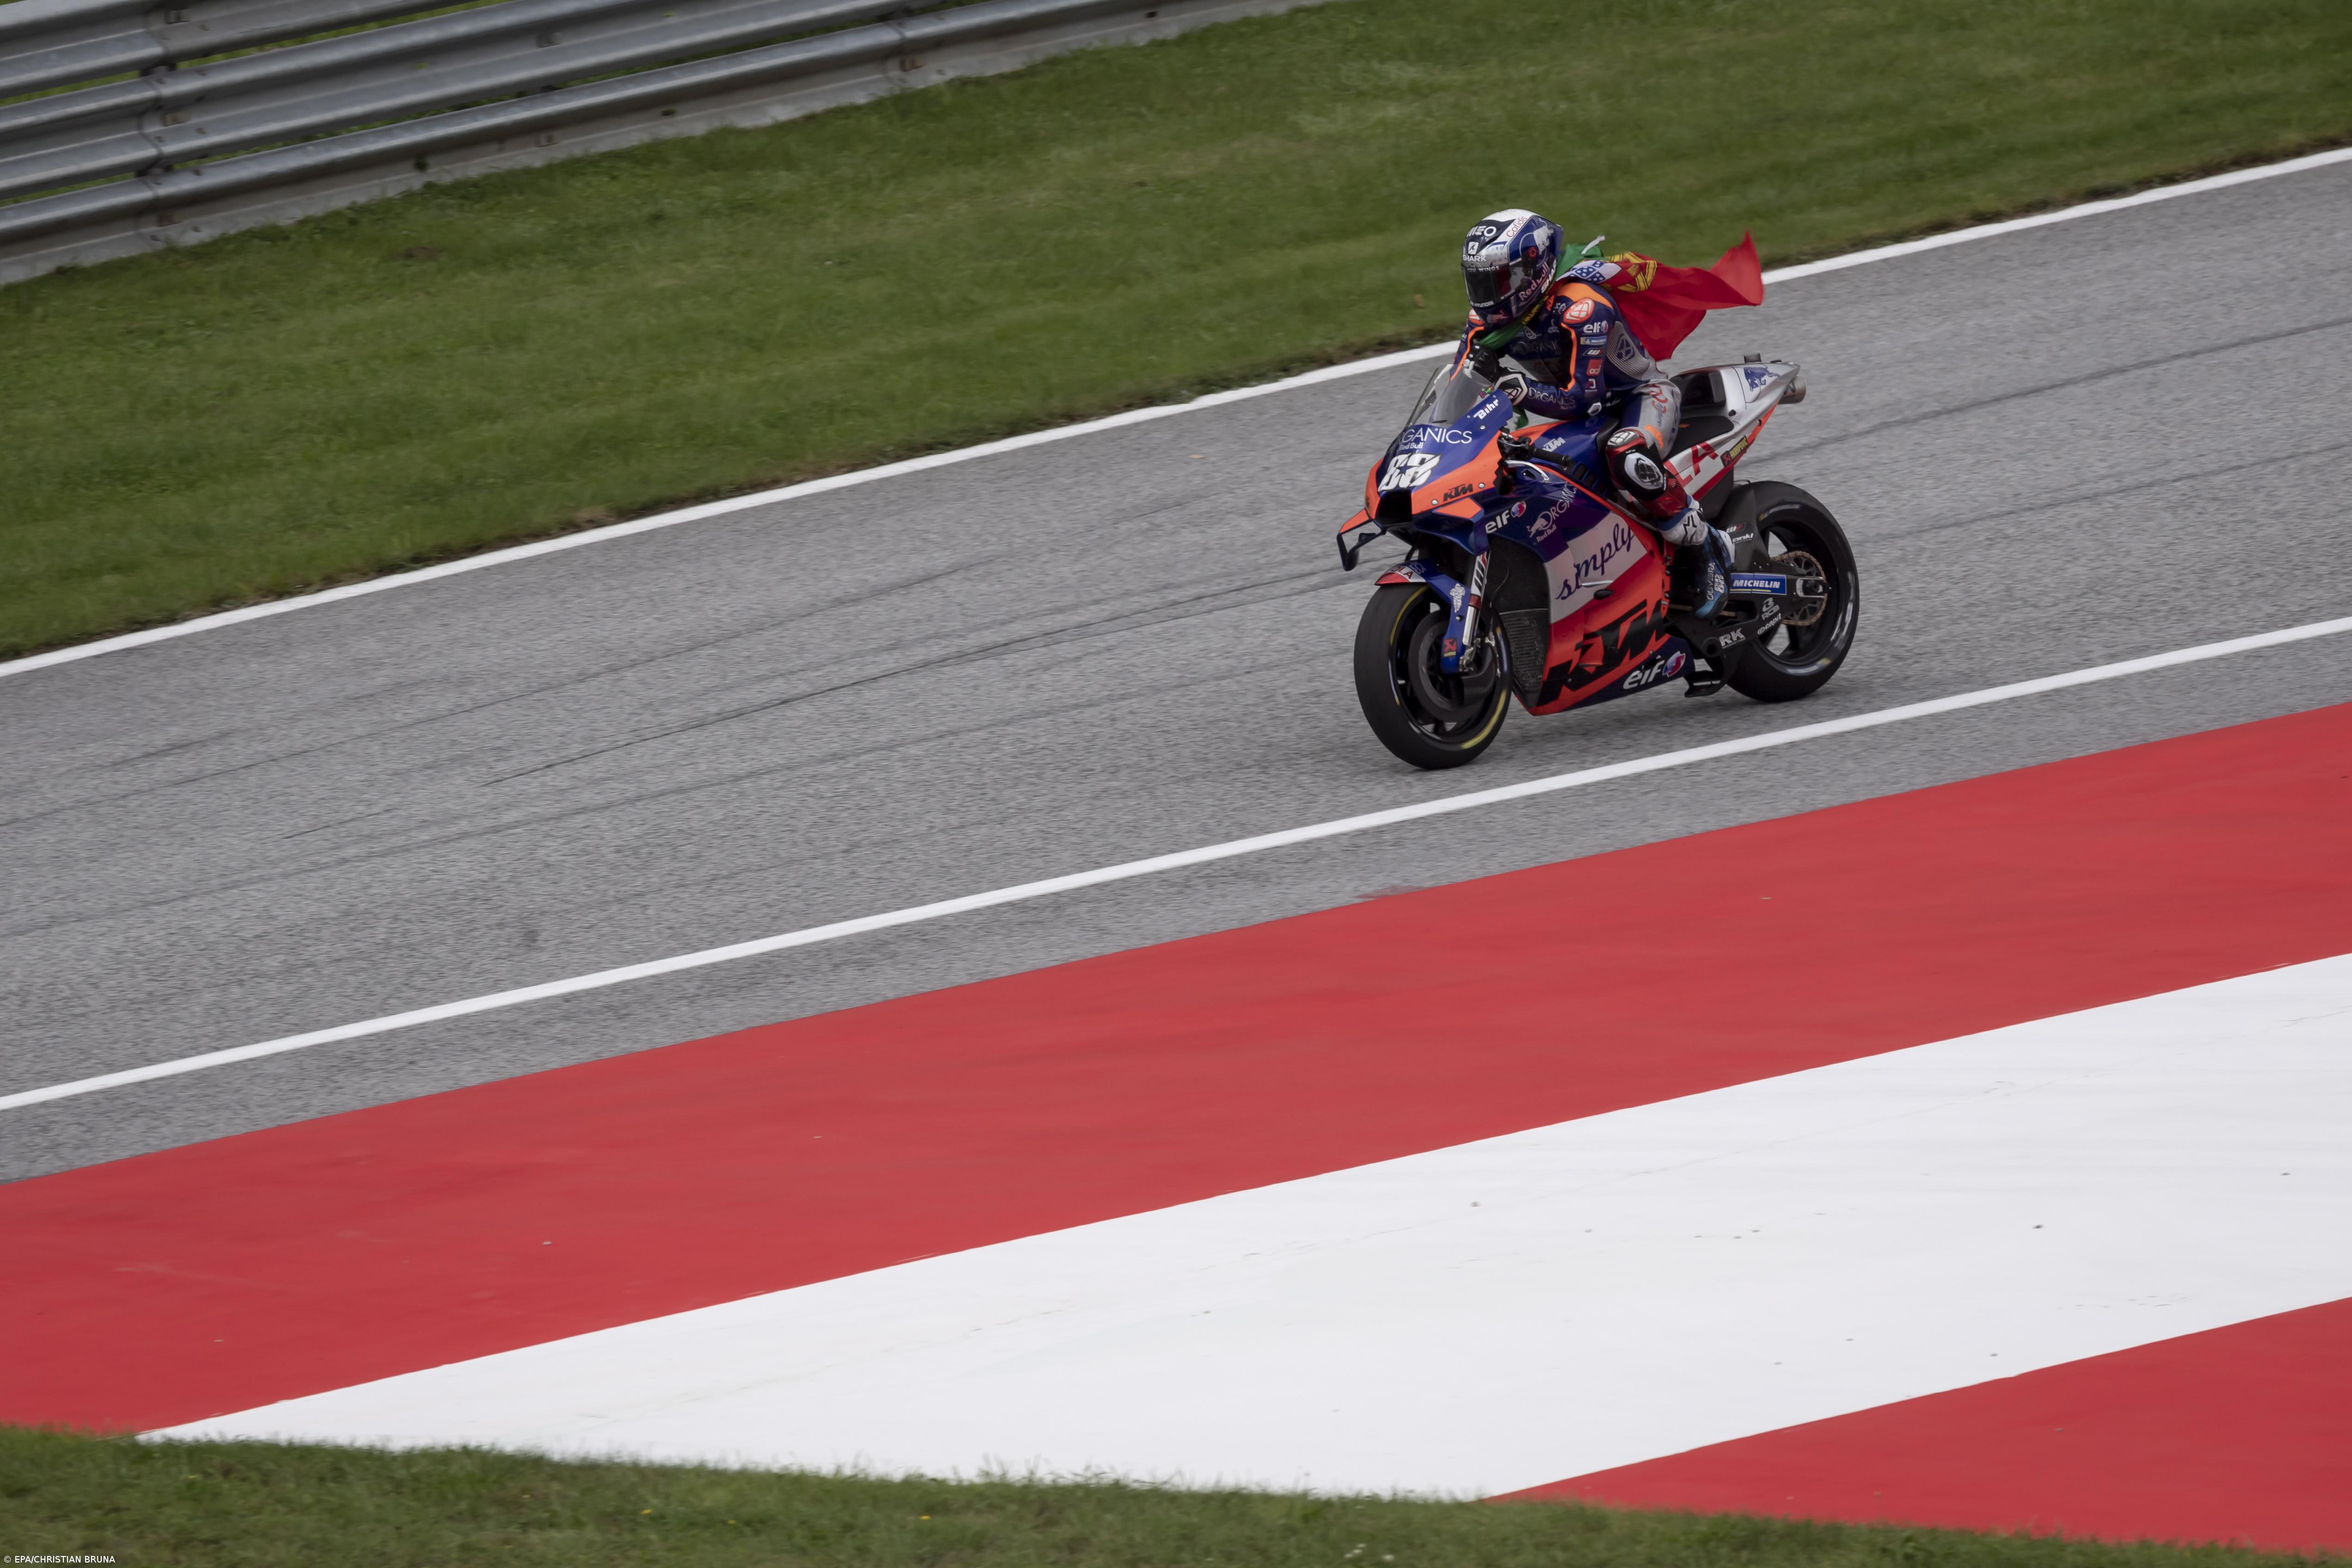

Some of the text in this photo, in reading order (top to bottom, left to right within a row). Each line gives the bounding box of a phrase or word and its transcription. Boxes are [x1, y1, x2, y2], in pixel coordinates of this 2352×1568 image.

[1466, 226, 1497, 237] MEO
[1506, 216, 1528, 238] Cofidis
[1541, 258, 1557, 294] SHAR
[1518, 279, 1538, 300] Red
[1583, 322, 1601, 333] elf
[1473, 398, 1499, 419] Bihr
[1402, 427, 1472, 444] GANICS
[1542, 437, 1566, 452] KTM
[1378, 453, 1441, 492] 88
[1664, 441, 1719, 489] LA
[1443, 483, 1474, 502] KTM
[1538, 481, 1578, 530] ORGANIC
[1485, 510, 1511, 534] elf
[1536, 524, 1557, 543] Red Bull
[1555, 523, 1635, 600] simply
[1733, 580, 1781, 588] MICHELIN
[1719, 628, 1745, 647] RK
[1536, 599, 1666, 707] KTM
[1623, 655, 1665, 689] elf
